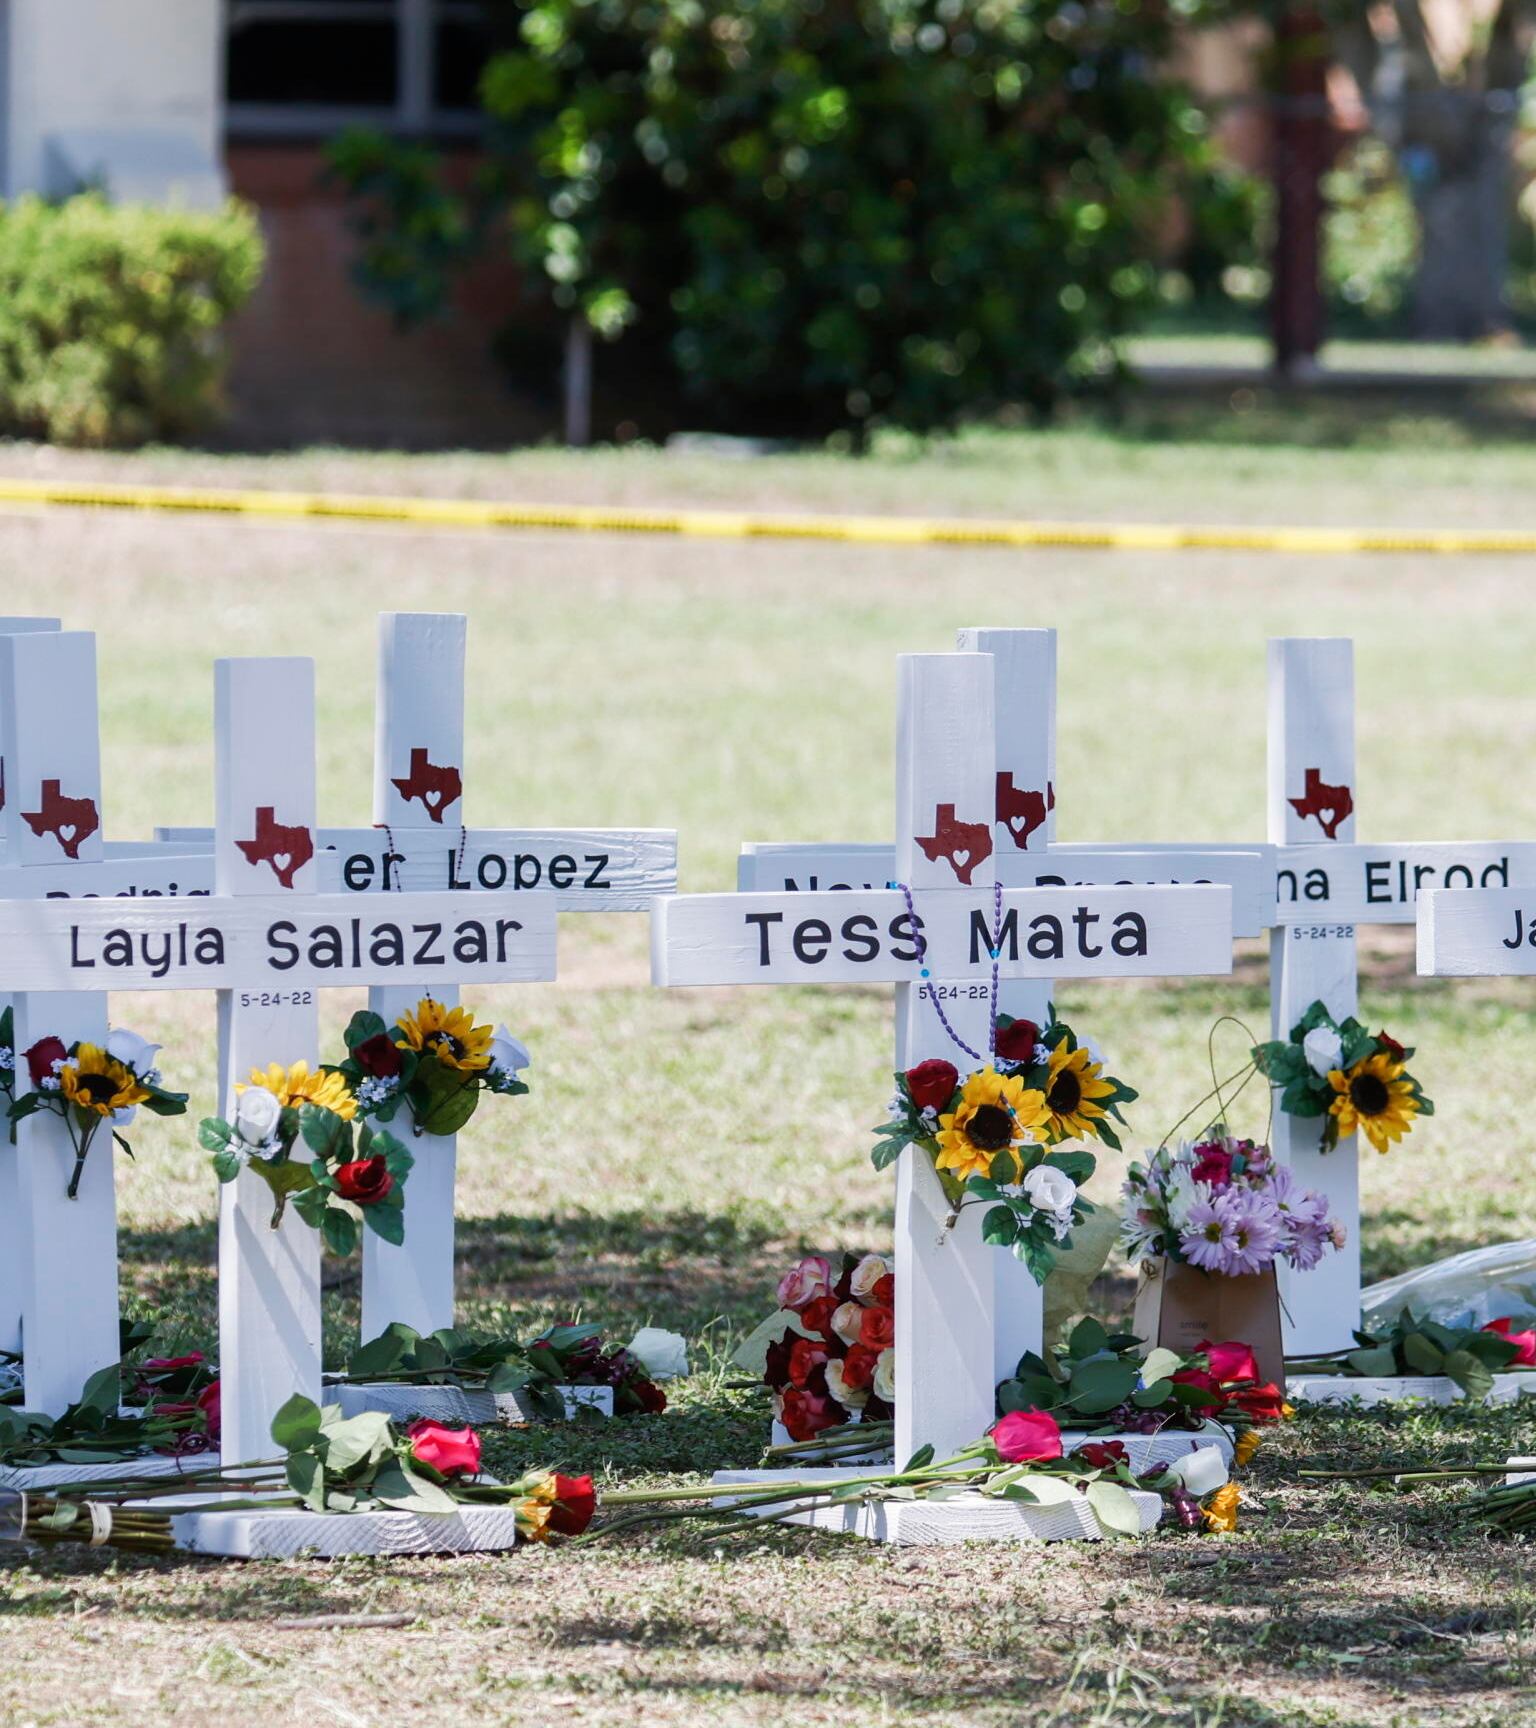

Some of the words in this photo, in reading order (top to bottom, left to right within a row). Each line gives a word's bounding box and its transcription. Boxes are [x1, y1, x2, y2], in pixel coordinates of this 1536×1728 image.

[448, 849, 611, 891] Lopez
[1365, 857, 1509, 903] Elrod
[70, 922, 225, 978] Layla
[266, 919, 523, 971] Salazar
[745, 910, 928, 967] Tess
[969, 906, 1148, 964] Mata
[1293, 926, 1354, 940] 5-24-22
[240, 991, 312, 1008] 5-24-22
[919, 985, 989, 1000] 524-22
